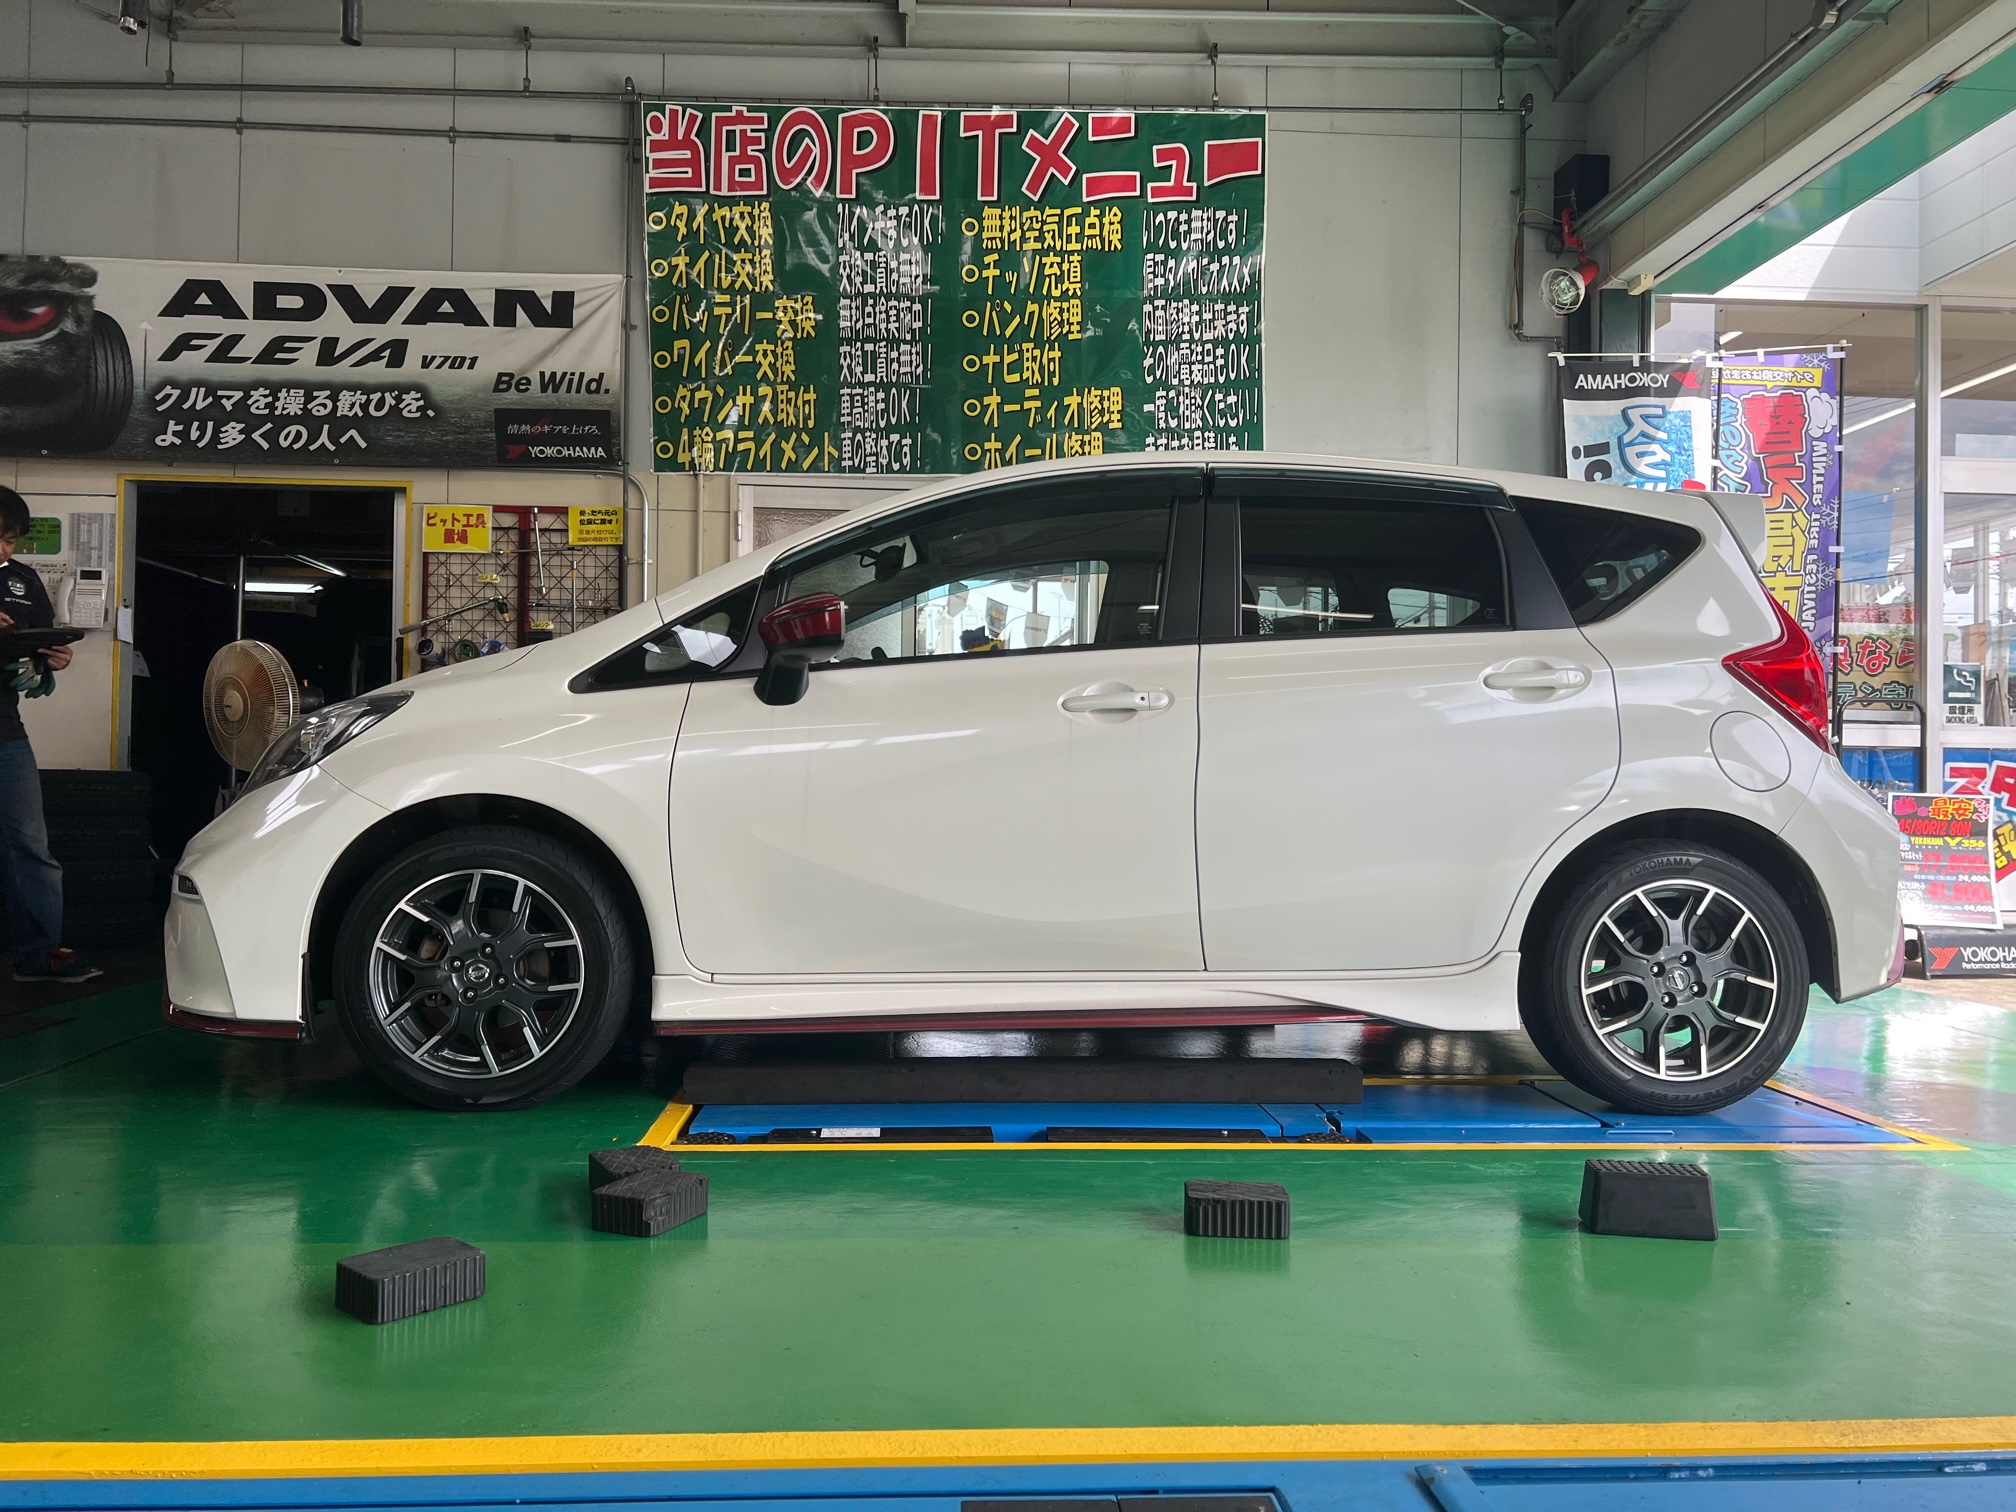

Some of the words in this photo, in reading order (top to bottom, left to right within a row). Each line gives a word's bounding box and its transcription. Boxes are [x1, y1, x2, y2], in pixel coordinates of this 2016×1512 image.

[157, 278, 576, 330] ADVAN
[156, 331, 410, 369] FLEVA
[420, 354, 480, 371] V701
[492, 371, 531, 394] Be
[537, 371, 612, 396] Wild.
[153, 420, 369, 453] より多くの人へ
[528, 446, 608, 458] YOKOHAMA
[426, 512, 487, 528] ピット工具
[444, 529, 469, 544] 置場
[1628, 857, 1692, 877] YOKOHAMA
